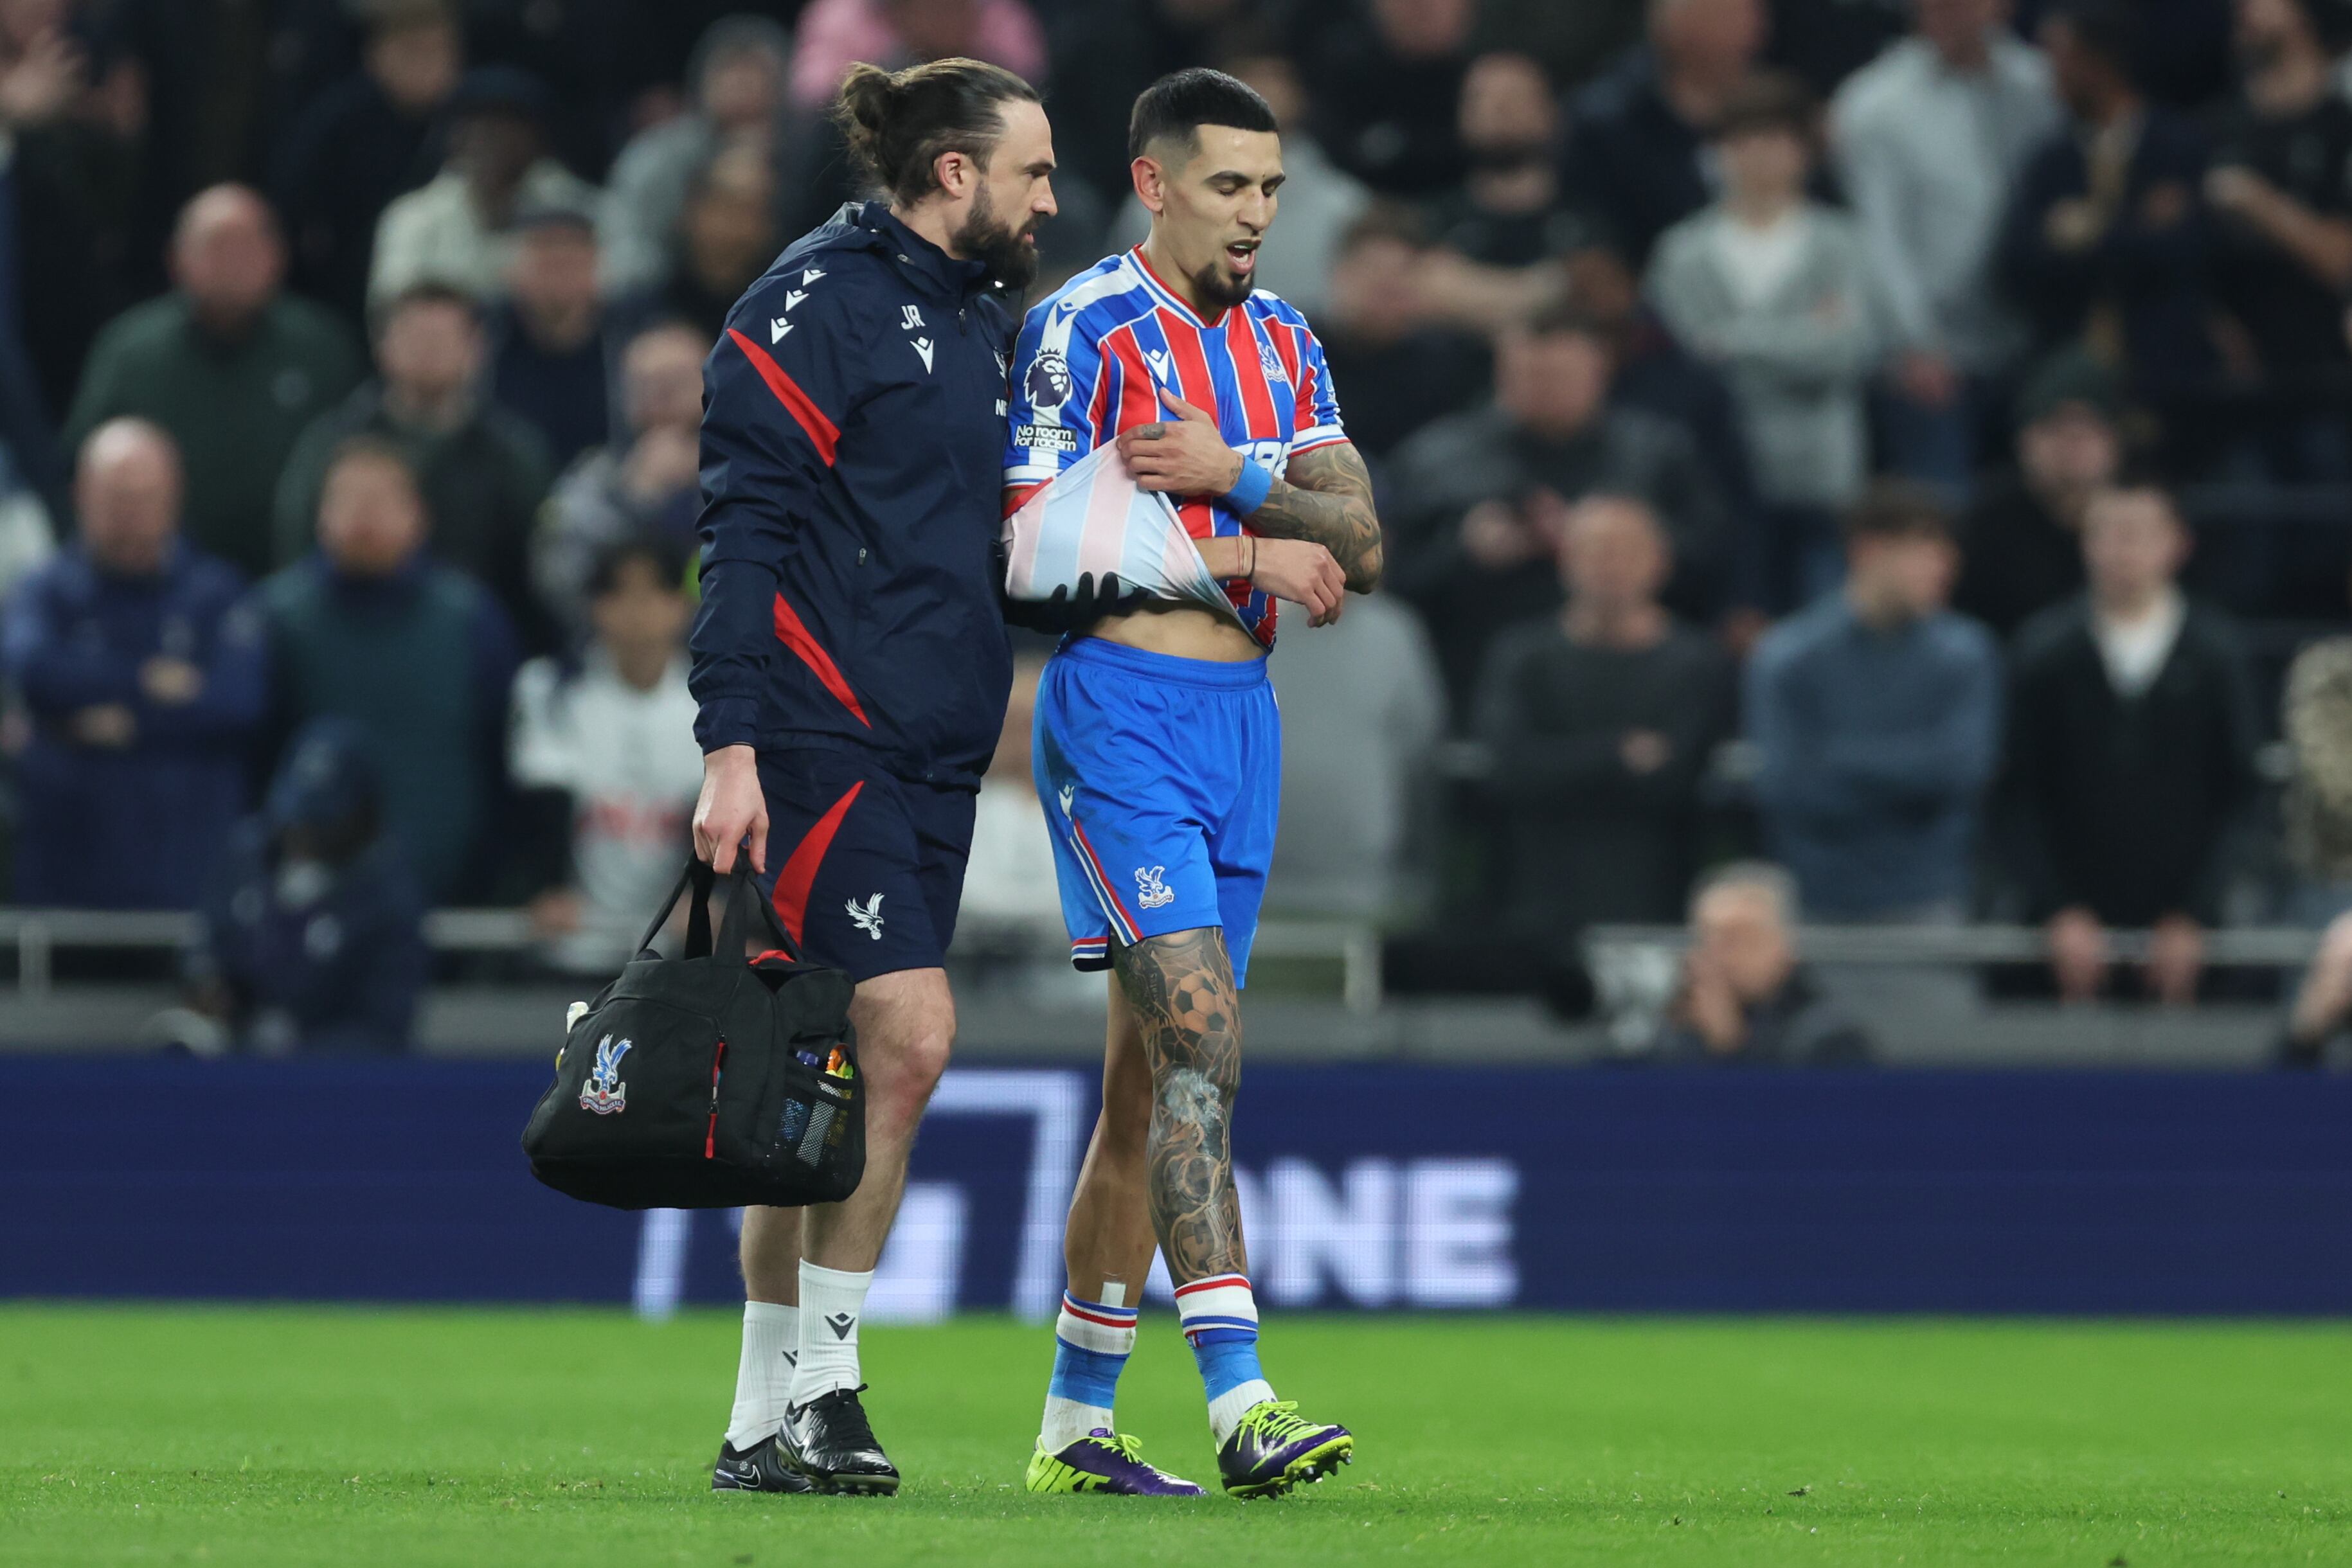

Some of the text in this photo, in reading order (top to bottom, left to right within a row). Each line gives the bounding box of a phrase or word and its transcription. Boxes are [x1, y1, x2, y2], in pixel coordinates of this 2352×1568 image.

[901, 305, 926, 330] JR
[1016, 425, 1071, 440] No room
[1014, 435, 1076, 451] for racism
